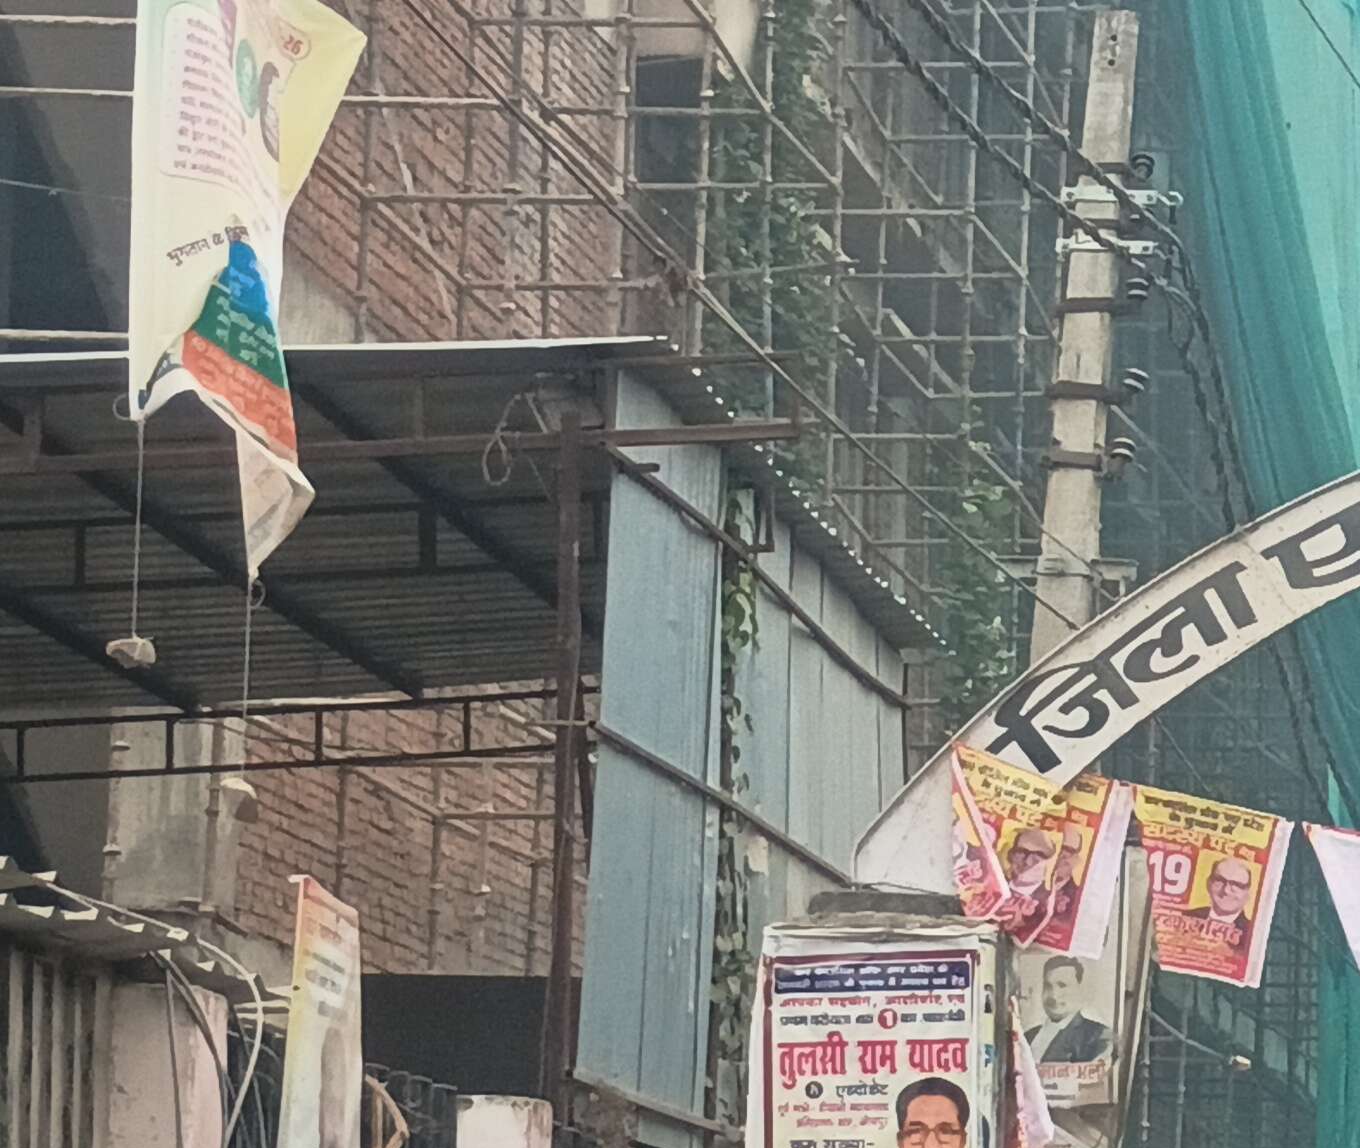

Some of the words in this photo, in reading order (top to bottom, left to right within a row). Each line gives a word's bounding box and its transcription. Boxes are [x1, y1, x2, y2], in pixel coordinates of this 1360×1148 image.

[983, 559, 1263, 775] जिला
[1148, 850, 1193, 895] 19
[777, 1031, 849, 1089] तुलसी
[857, 1039, 898, 1075] राम
[906, 1037, 970, 1074] यादव
